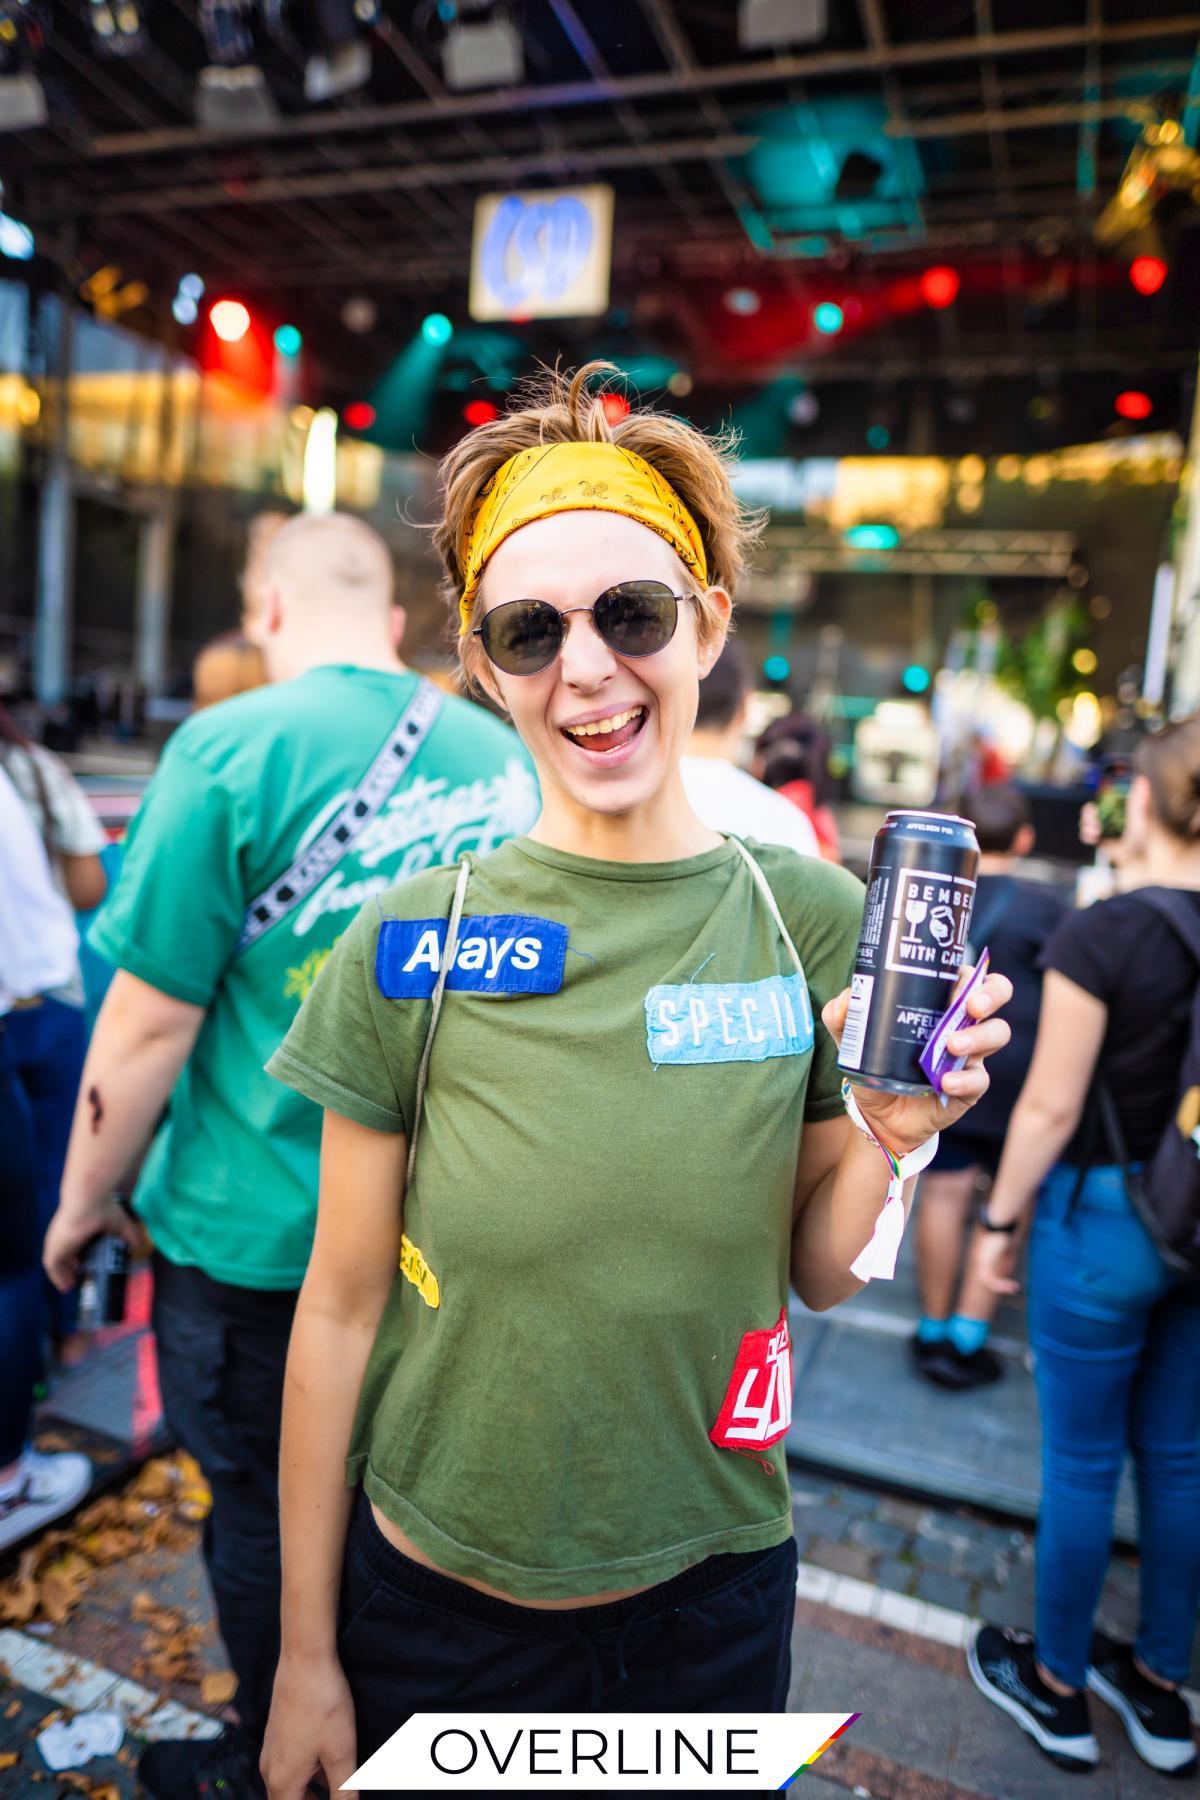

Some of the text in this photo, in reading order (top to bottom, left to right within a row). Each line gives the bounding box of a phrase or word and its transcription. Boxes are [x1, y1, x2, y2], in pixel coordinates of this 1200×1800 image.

[402, 930, 542, 979] Aays
[900, 942, 936, 962] WITH
[896, 1010, 940, 1029] APFEL
